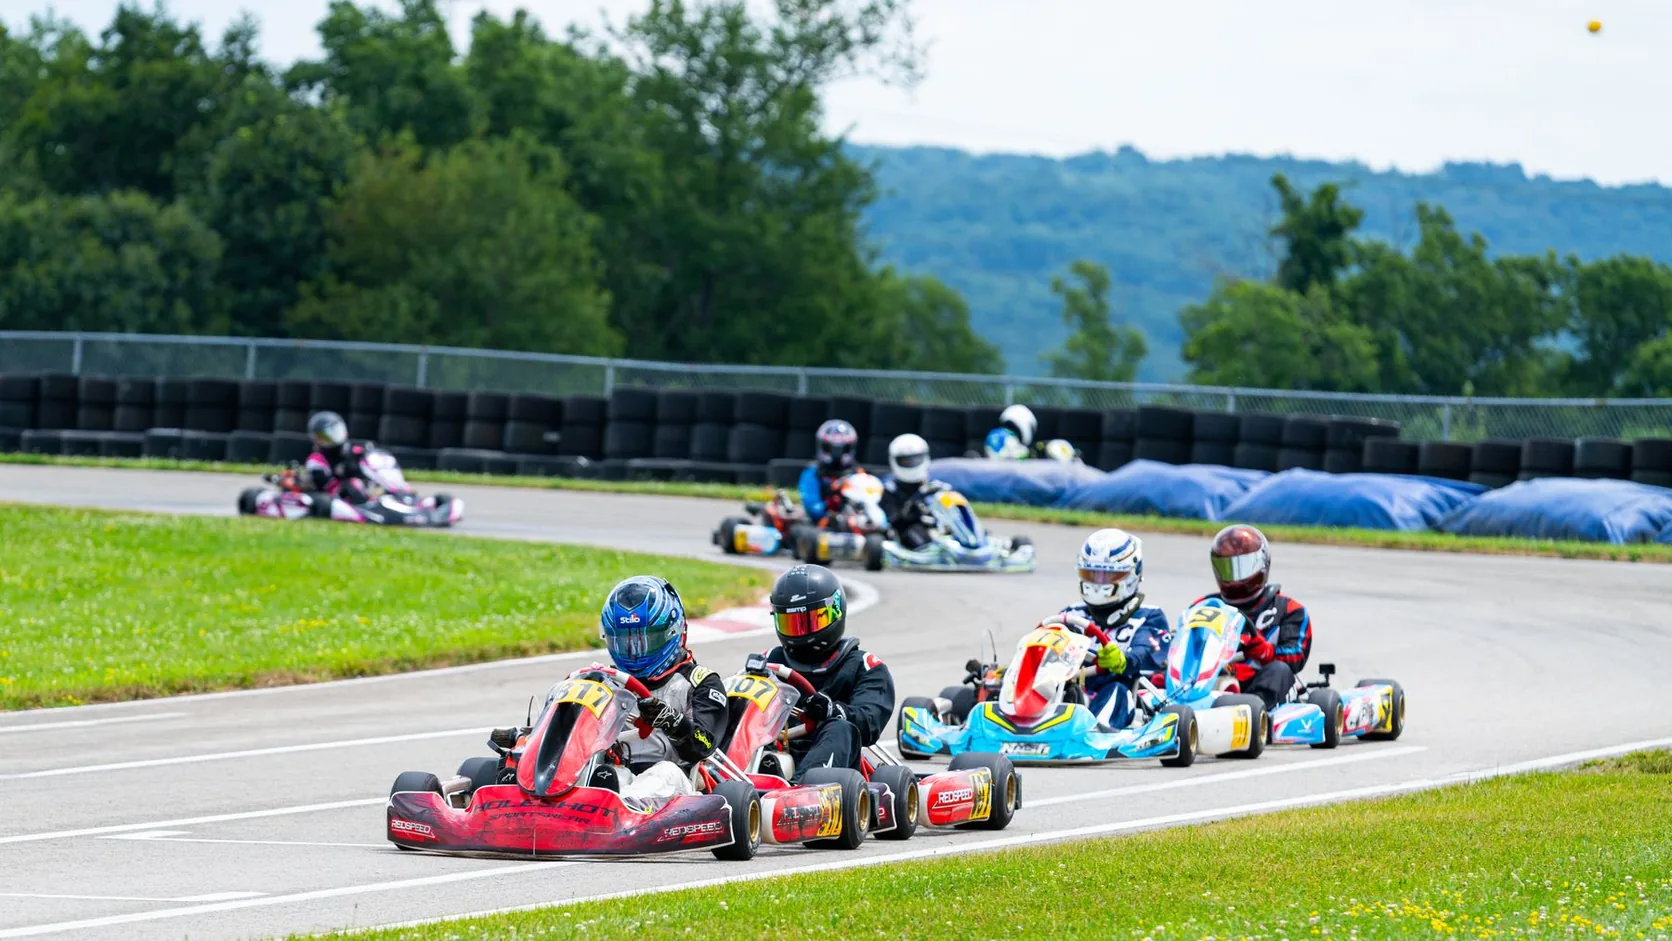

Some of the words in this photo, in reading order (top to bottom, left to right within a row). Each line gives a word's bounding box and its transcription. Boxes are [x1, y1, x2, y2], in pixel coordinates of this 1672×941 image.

[620, 613, 641, 624] Stilo
[938, 787, 974, 804] REDSPEED
[475, 799, 618, 817] HOLESHOT
[391, 819, 431, 834] REDSPEED
[664, 821, 723, 836] REDSPEED
